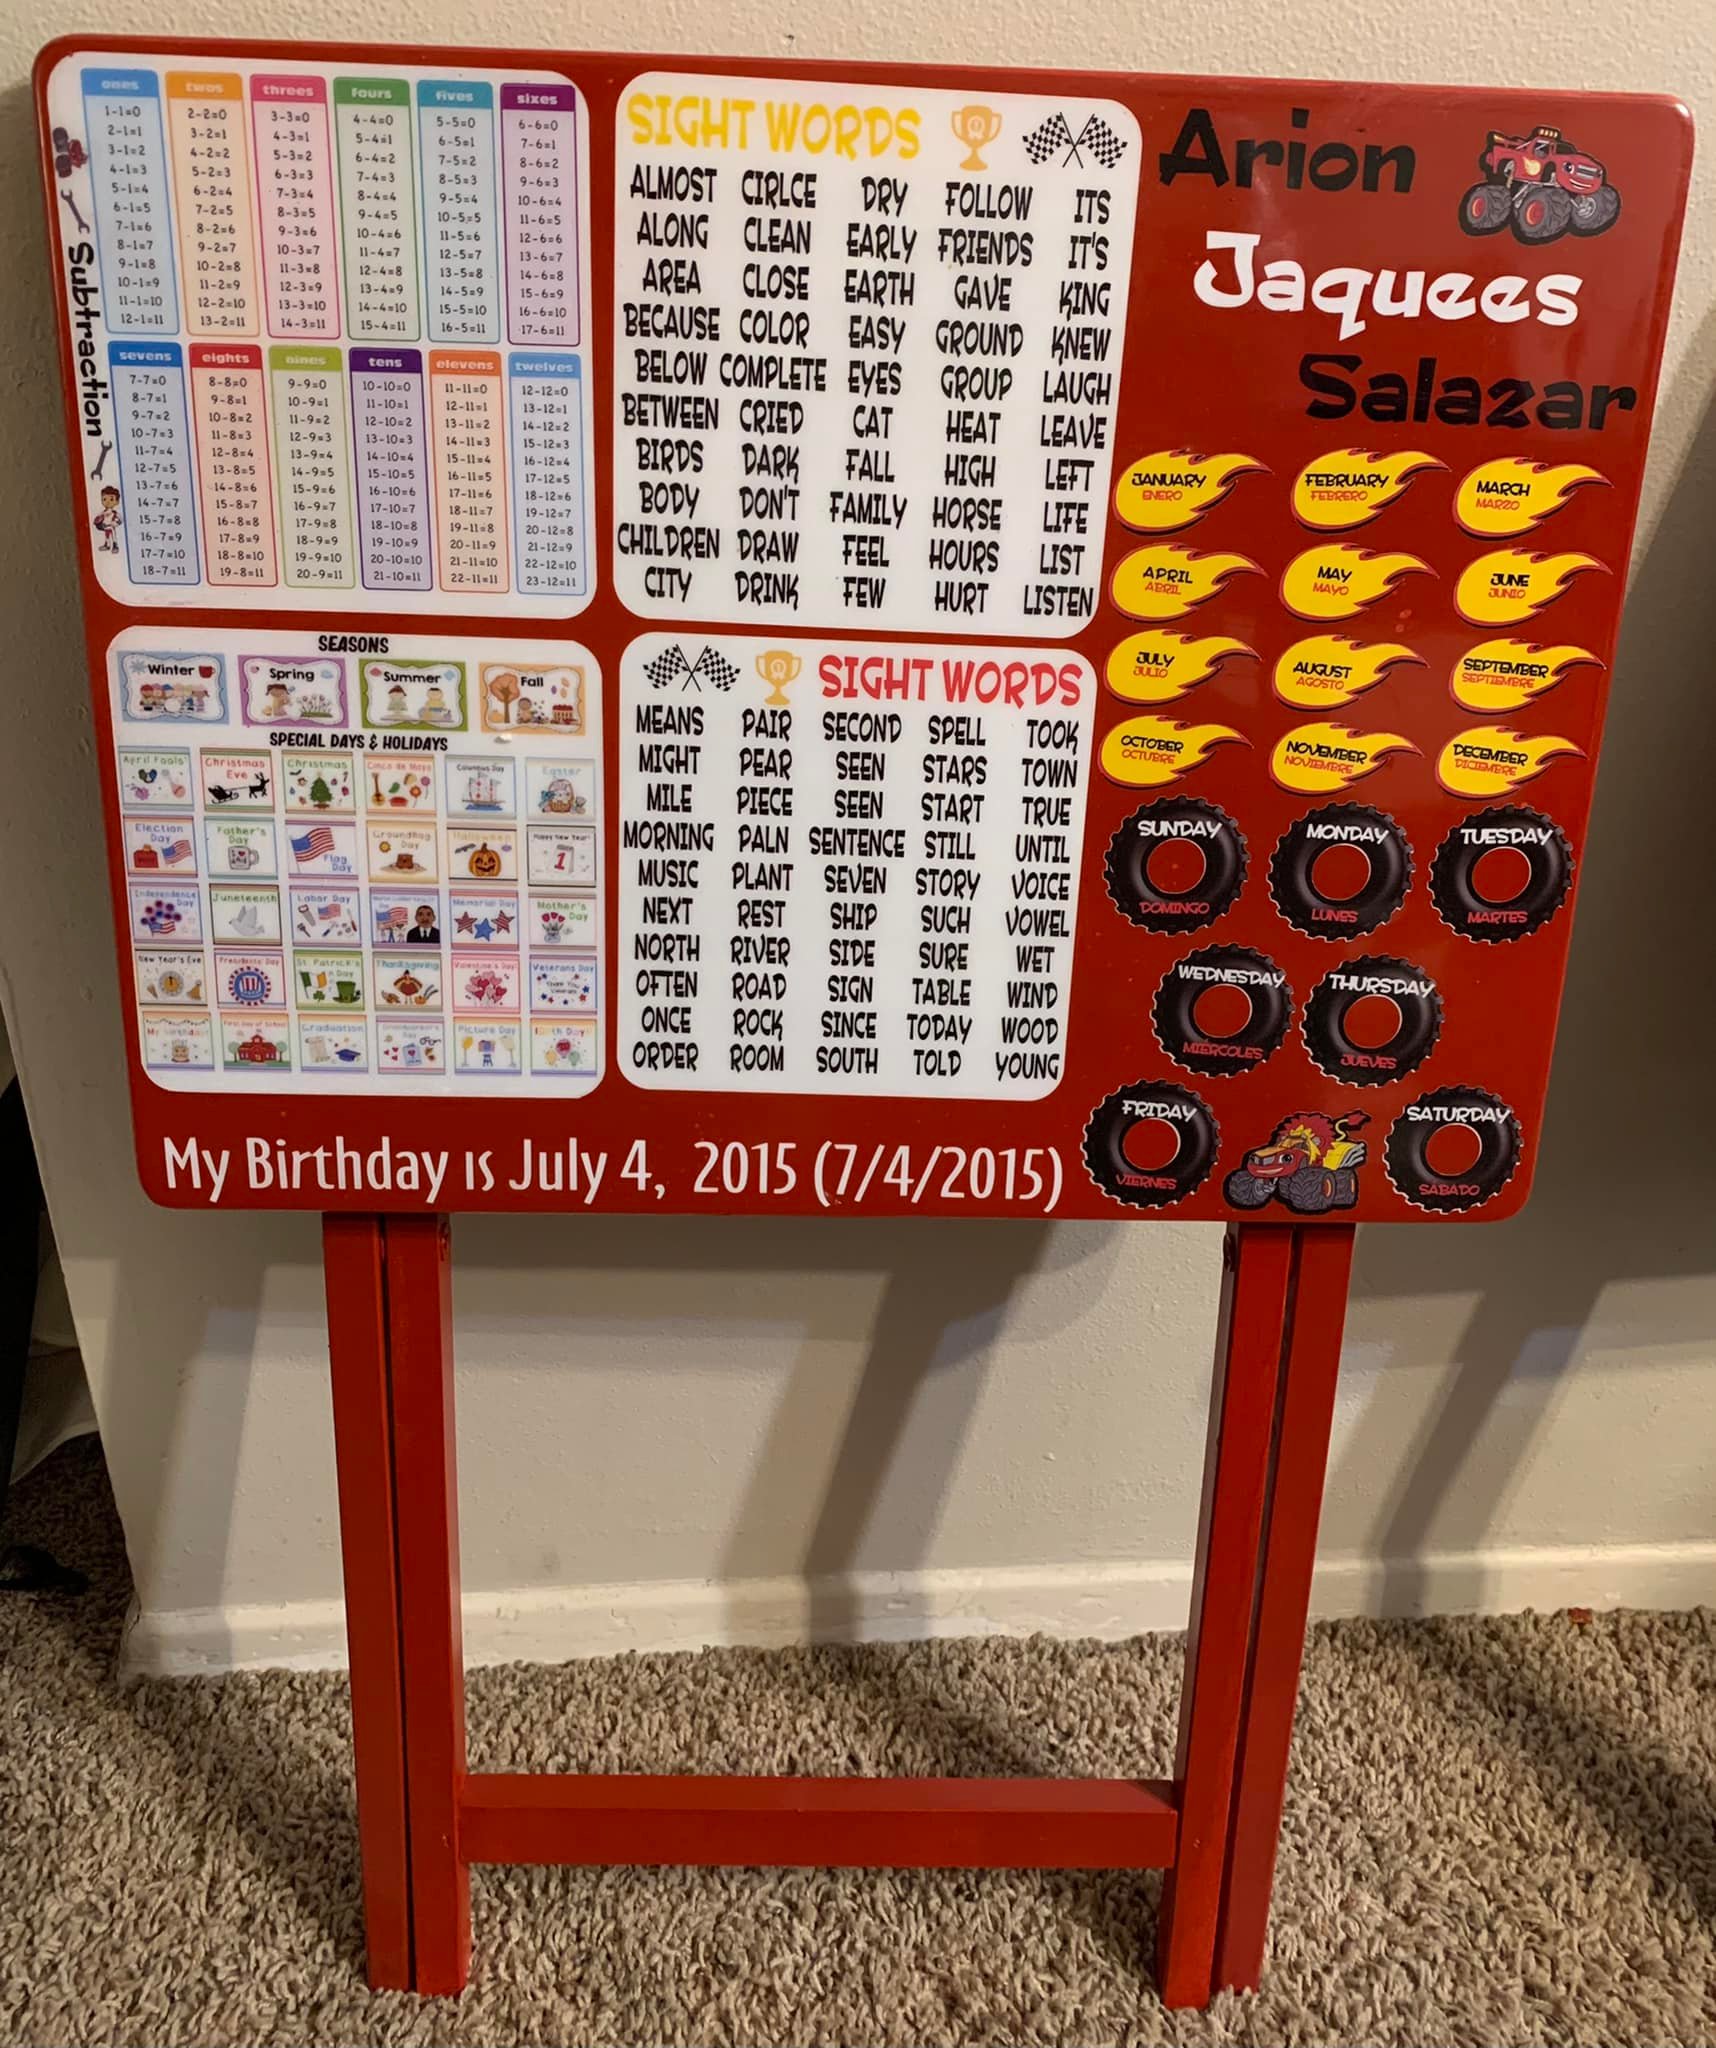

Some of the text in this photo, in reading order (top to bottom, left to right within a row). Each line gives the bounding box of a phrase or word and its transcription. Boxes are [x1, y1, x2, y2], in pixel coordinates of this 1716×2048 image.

[102, 81, 139, 89] ones
[186, 83, 223, 92] twos
[263, 86, 313, 96] threes
[352, 88, 391, 98] fours
[436, 91, 473, 101] fives
[518, 94, 557, 104] sixes
[627, 92, 921, 161] SIGHT WORDS
[1159, 108, 1416, 195] Arion
[630, 164, 717, 202] ALMOST
[742, 170, 816, 209] CIRLCE
[861, 176, 908, 217] DRY
[946, 182, 1033, 220] FOLLOW
[1075, 189, 1111, 224] ITS
[643, 258, 701, 296] AREA
[743, 263, 809, 300] CLOSE
[1194, 230, 1583, 342] Jaquees
[844, 269, 914, 307] EARTH
[955, 274, 1011, 311] GAVE
[1060, 281, 1111, 321] KING
[69, 242, 108, 437] Subtraction
[120, 352, 171, 361] sevens
[202, 353, 249, 363] eights
[286, 356, 326, 364] nines
[369, 358, 402, 367] tens
[437, 360, 493, 369] elevens
[516, 363, 572, 372] twelves
[635, 349, 707, 385] BELOW
[720, 353, 826, 391] COMPLETE
[848, 360, 902, 398] EYES
[941, 365, 1012, 402] GROUP
[1043, 371, 1111, 405] LAUGH
[1300, 354, 1637, 431] Salazar
[1132, 474, 1206, 487] JANUARY
[1306, 474, 1388, 487] FEBRUARY
[1477, 481, 1530, 496] MARCH
[639, 481, 699, 519] BODY
[740, 486, 800, 520] DON'T
[1142, 489, 1184, 501] ENERO
[1310, 489, 1369, 502] FEBRERO
[1475, 497, 1520, 511] MARZO
[830, 492, 907, 529] FAMILY
[933, 496, 1002, 532] HORSE
[1044, 502, 1088, 534] LIFE
[1144, 567, 1192, 583] APRIL
[1318, 567, 1352, 582] MAY
[1491, 574, 1529, 586] JUNE
[1144, 581, 1182, 596] ABRIL
[1312, 581, 1349, 596] MAYO
[1487, 586, 1526, 600] JUNIO
[319, 635, 388, 653] SEASONS
[1137, 652, 1174, 667] JULY
[1464, 659, 1548, 678] SEPTEMBER
[148, 664, 194, 675] Winter
[270, 668, 314, 681] Spring
[384, 672, 440, 683] Summer
[1132, 665, 1168, 679] JULIO
[1294, 662, 1351, 678] AUGUST
[521, 677, 543, 686] Fall
[819, 654, 1083, 709] SIGHT WORDS
[1295, 676, 1345, 690] AGOSTO
[1461, 672, 1535, 689] SEPTIEMBRE
[636, 705, 704, 735] MEANS
[742, 709, 791, 742] PAIR
[823, 711, 901, 743] SECOND
[929, 715, 985, 746] SPELL
[1027, 720, 1079, 755] TOOK
[270, 732, 447, 751] SPECIAL DAYS & HOLIDAYS
[1122, 736, 1183, 753] OCTOBER
[1121, 749, 1175, 765] OCTUBRE
[1287, 741, 1366, 763] NOVEMBER
[1454, 744, 1527, 765] DECEMBER
[205, 758, 266, 768] Christmas
[286, 760, 348, 769] Christmas
[1284, 753, 1353, 775] NOVIEMBRE
[1454, 759, 1517, 777] DICIEMBRE
[226, 770, 248, 779] Eve
[135, 824, 184, 833] Election
[624, 821, 714, 852] MORNING
[1138, 821, 1222, 839] SUNDAY
[1307, 824, 1388, 845] MONDAY
[1461, 828, 1553, 845] TUESDAY
[150, 833, 172, 843] Day
[228, 836, 249, 845] Day
[738, 824, 788, 853] PALN
[809, 827, 905, 857] SENTENCE
[925, 831, 975, 860] STILL
[1016, 834, 1070, 863] UNTIL
[332, 863, 353, 873] Day
[212, 894, 277, 904] Juneteenth
[297, 895, 351, 904] Labor Day
[537, 902, 586, 911] Mother's
[1140, 902, 1209, 913] DOMINGO
[569, 912, 588, 922] Day
[643, 897, 693, 924] NEXT
[737, 899, 786, 929] REST
[831, 902, 877, 930] SHIP
[921, 905, 971, 933] SUCH
[1312, 909, 1358, 922] LUNES
[1468, 911, 1527, 924] MARTES
[1006, 907, 1069, 937] VOWEL
[1179, 965, 1285, 988] WEDNESDAY
[1330, 975, 1435, 998] THURSDAY
[633, 1041, 698, 1071] ORDER
[730, 1044, 784, 1072] ROOM
[1183, 1041, 1263, 1059] MIERCOLES
[816, 1046, 878, 1074] SOUTH
[914, 1049, 961, 1076] TOLD
[996, 1052, 1059, 1081] YOUNG
[1341, 1054, 1396, 1069] JUEVES
[1123, 1101, 1196, 1123] FRIDAY
[1407, 1107, 1510, 1125] SATURDAY
[164, 1136, 1062, 1212] My Birthday is July 4, 2015 (7/4/2015)
[1117, 1174, 1176, 1189] VIERNES
[1419, 1184, 1479, 1195] SABADO
